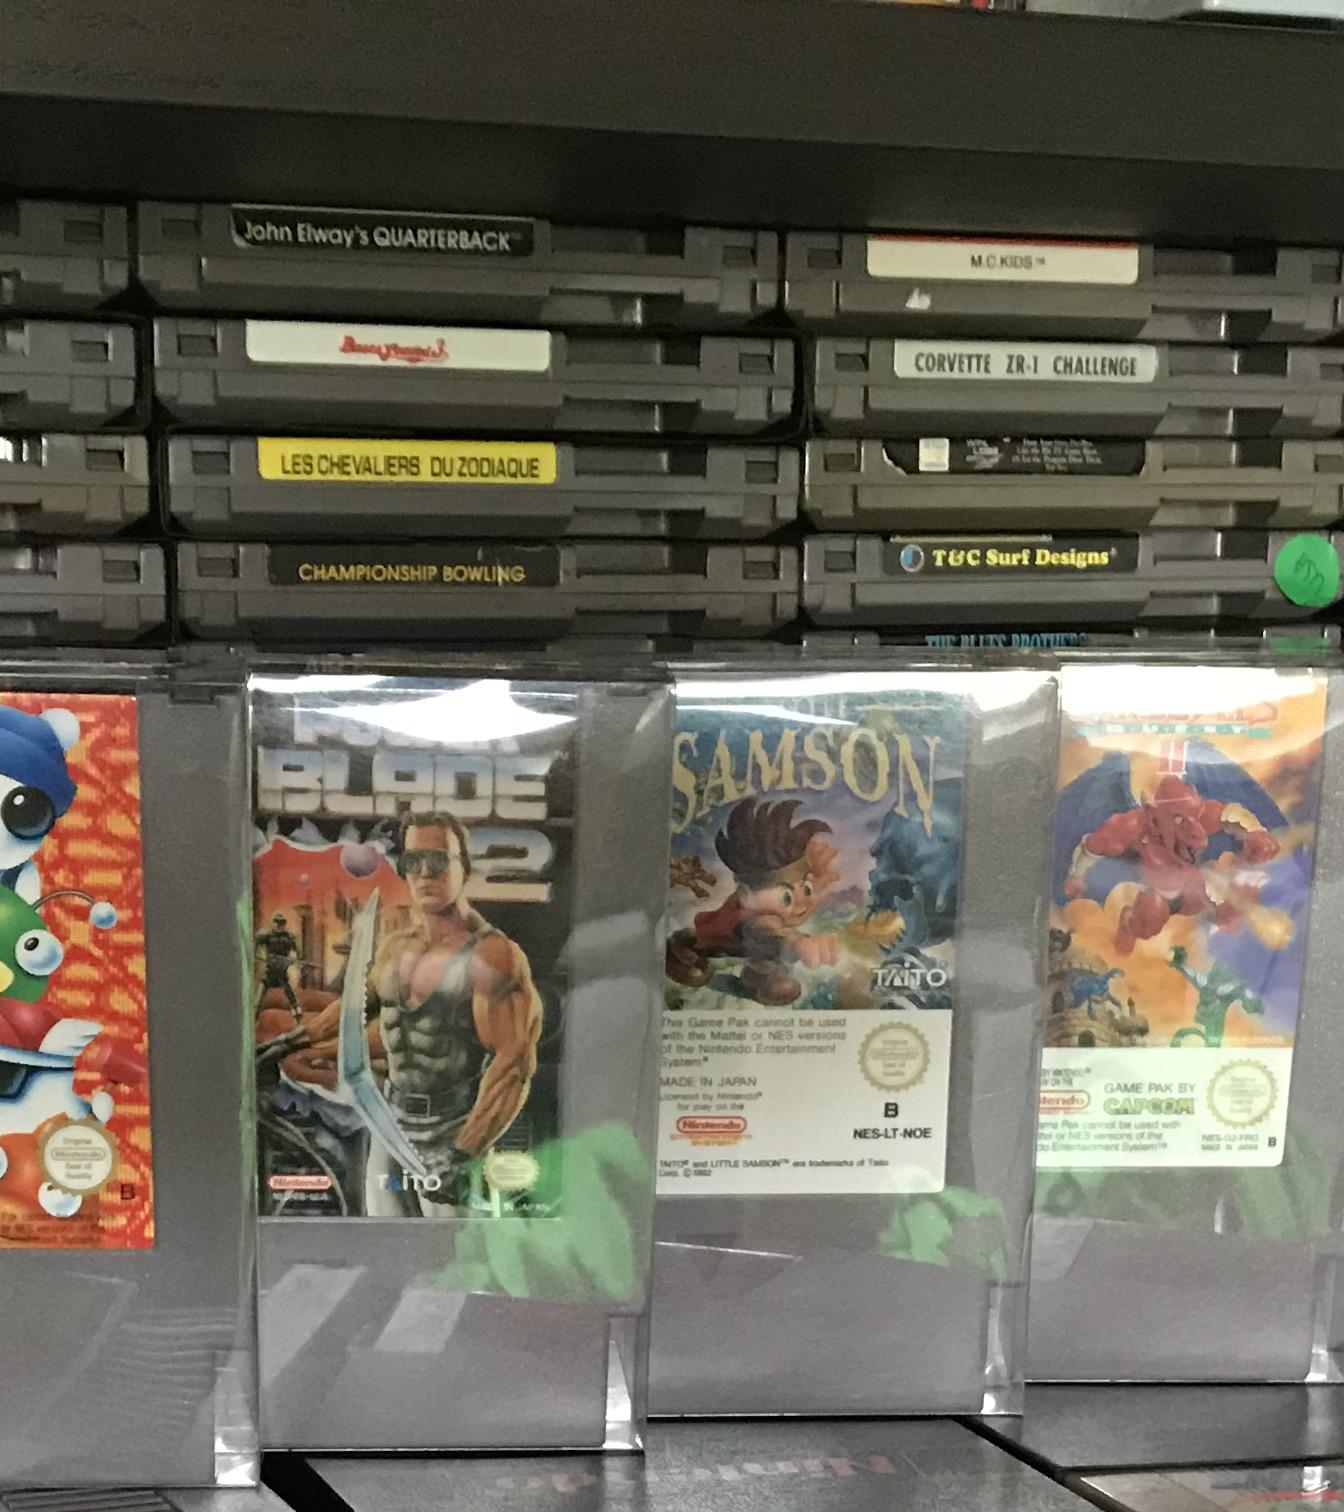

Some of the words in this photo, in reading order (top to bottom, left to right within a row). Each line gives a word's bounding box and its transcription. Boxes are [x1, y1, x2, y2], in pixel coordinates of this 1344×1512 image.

[244, 220, 292, 243] John
[297, 223, 369, 249] Elway's
[374, 227, 511, 252] QUARTERBACK
[914, 352, 992, 374] CORVETTE
[1006, 353, 1039, 375] ZR-1
[1054, 354, 1137, 377] CHALLENGE
[281, 454, 314, 475] LES
[317, 455, 420, 477] CHEVALIERS
[431, 456, 454, 477] DU
[456, 456, 539, 480] ZODIAQUE
[932, 548, 981, 567] T&C
[985, 548, 1030, 567] Surf
[1035, 547, 1109, 570] Designs
[298, 562, 438, 583] CHAMPIONSHIP
[442, 563, 526, 585] BOWLING
[669, 728, 941, 839] SAMSON
[256, 748, 553, 821] BLADE
[464, 826, 553, 902] 2
[873, 961, 949, 991] TAITO
[884, 1102, 899, 1118] B
